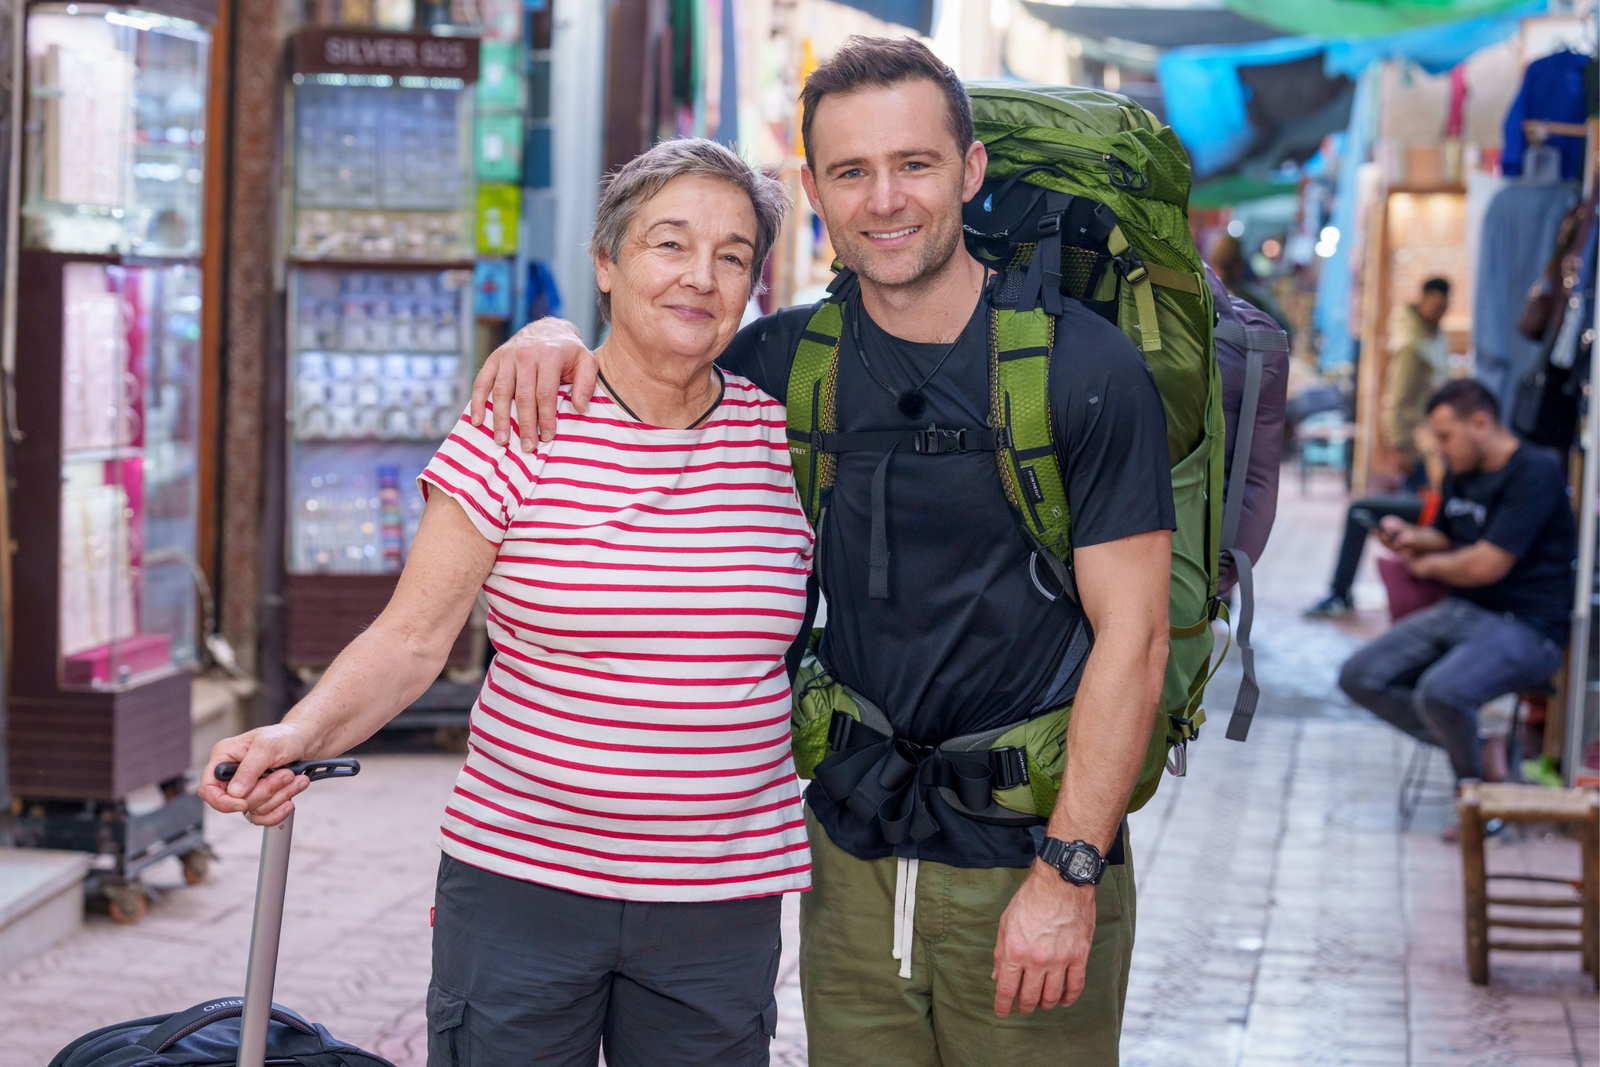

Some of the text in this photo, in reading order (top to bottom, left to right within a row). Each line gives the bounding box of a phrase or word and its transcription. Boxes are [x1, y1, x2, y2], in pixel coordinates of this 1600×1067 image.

[325, 36, 418, 67] SILVER
[789, 446, 807, 456] SPREY
[203, 999, 244, 1012] OSPRE
